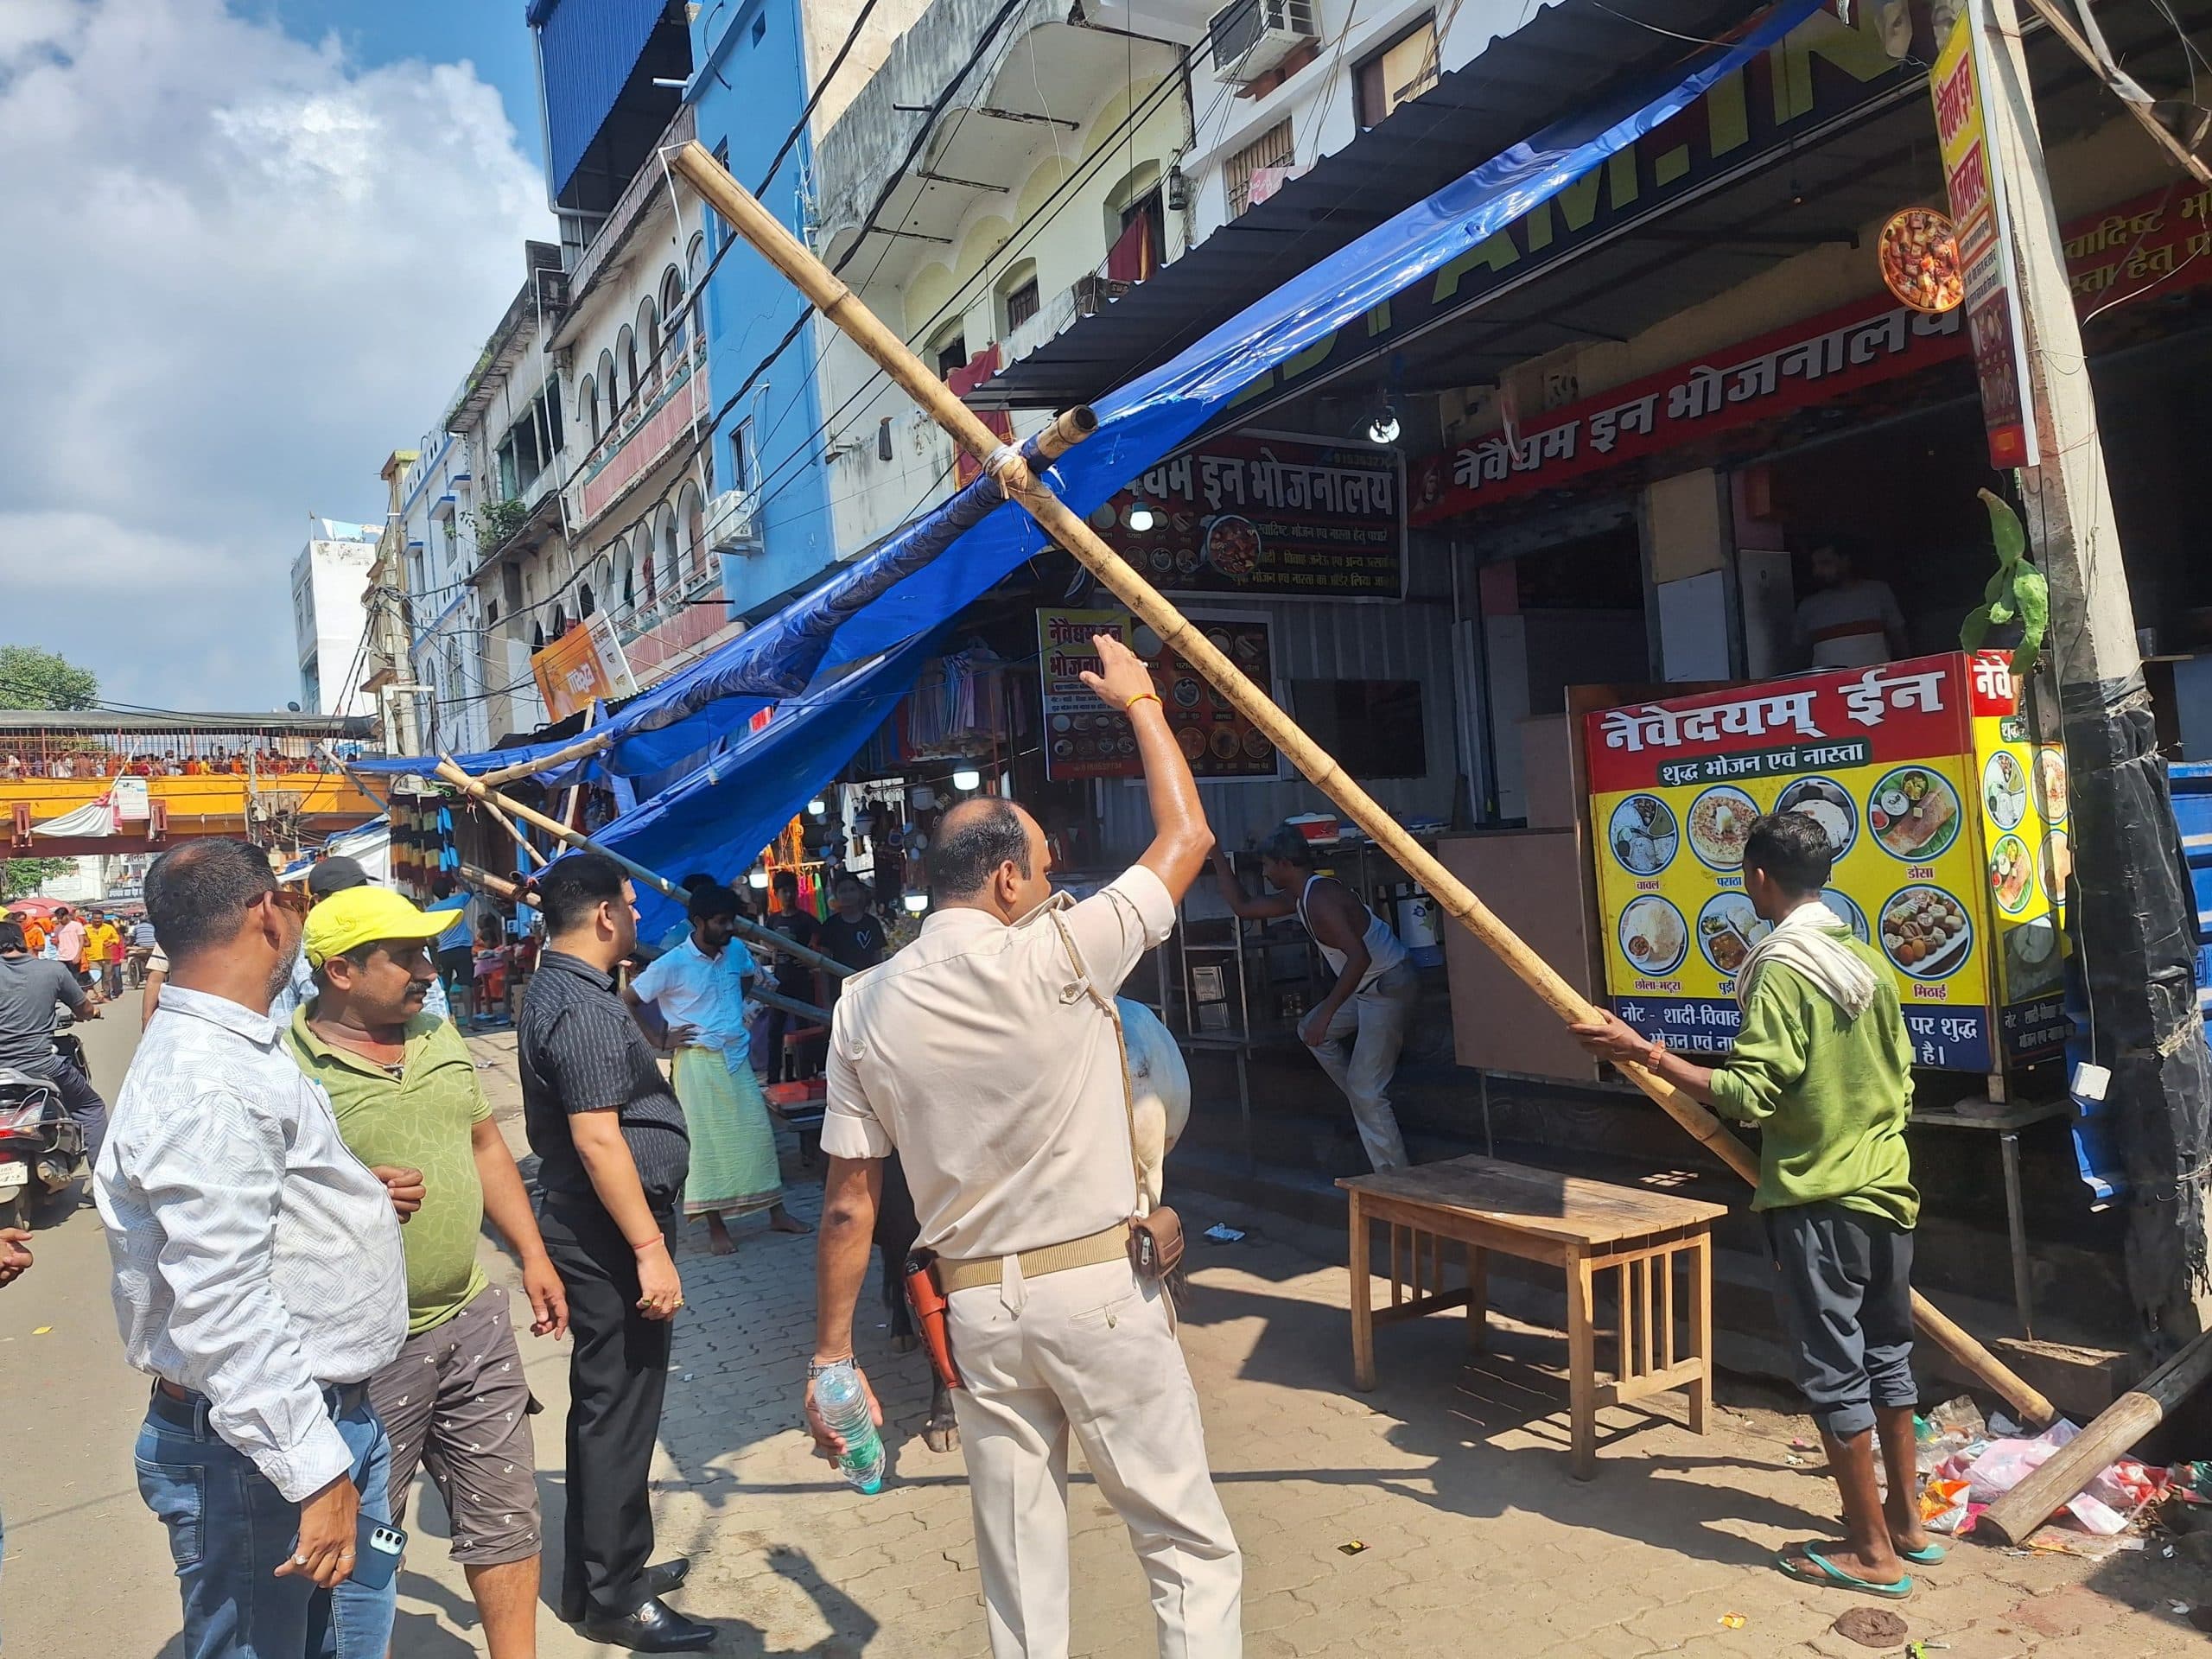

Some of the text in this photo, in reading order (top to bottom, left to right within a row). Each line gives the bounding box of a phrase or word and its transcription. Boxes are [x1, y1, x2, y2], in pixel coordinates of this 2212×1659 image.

[2063, 208, 2165, 258] वादिष्ट
[1588, 393, 1660, 454] इन
[1199, 454, 1245, 511] इन
[1250, 447, 1394, 517] भोजनालय
[1838, 668, 1946, 727] ईन
[1973, 655, 2014, 700] नेवे
[1662, 742, 1864, 785] शुद्ध भोजन एवं नास्ता
[1906, 865, 1935, 880] डोसा
[1621, 1001, 1646, 1022] नोट
[1913, 983, 1947, 1001] मिठाई
[1691, 1030, 1713, 1052] एवं
[1909, 1016, 1978, 1043] पर शुद्ध
